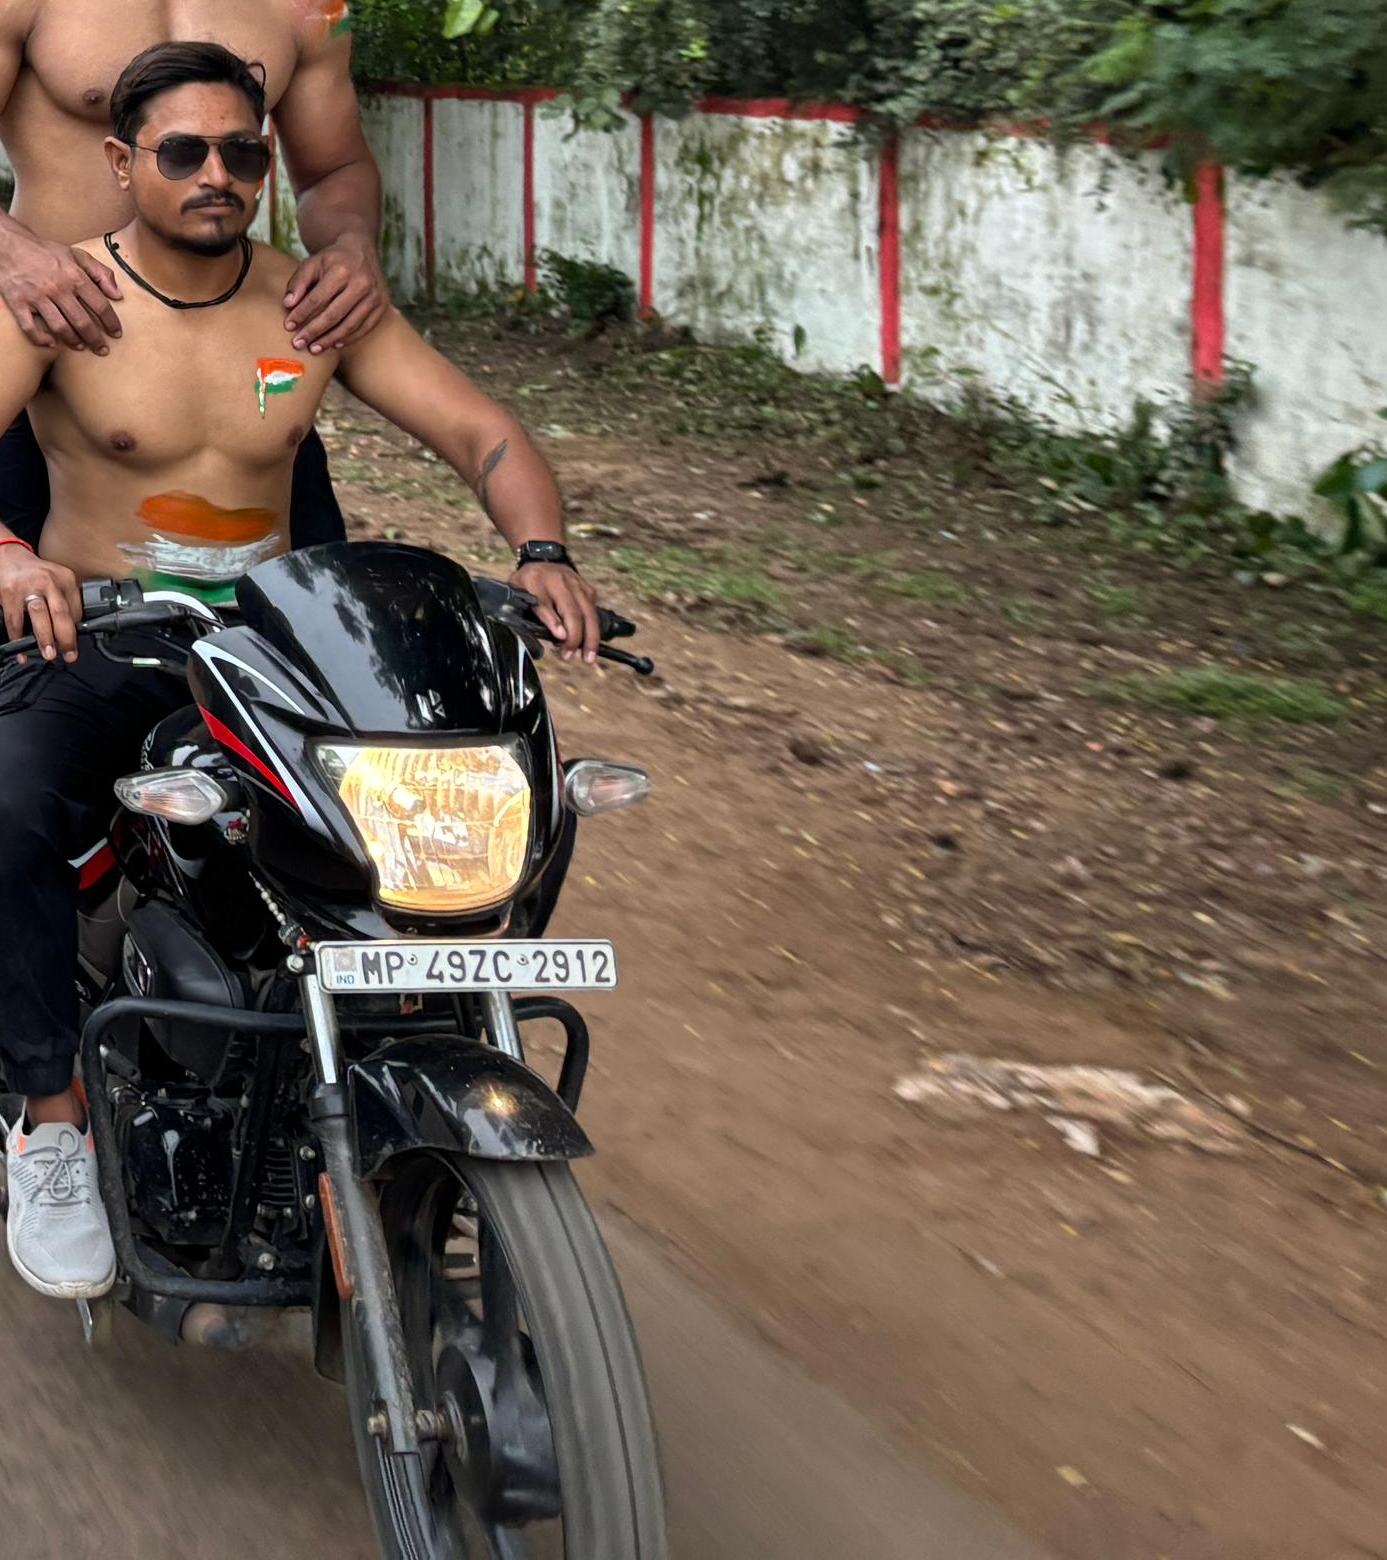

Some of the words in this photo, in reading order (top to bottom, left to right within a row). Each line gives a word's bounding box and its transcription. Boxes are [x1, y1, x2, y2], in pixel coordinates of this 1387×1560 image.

[361, 950, 404, 985] MP
[426, 949, 512, 984] 49ZC
[532, 949, 611, 984] 2912
[336, 975, 355, 986] IND
